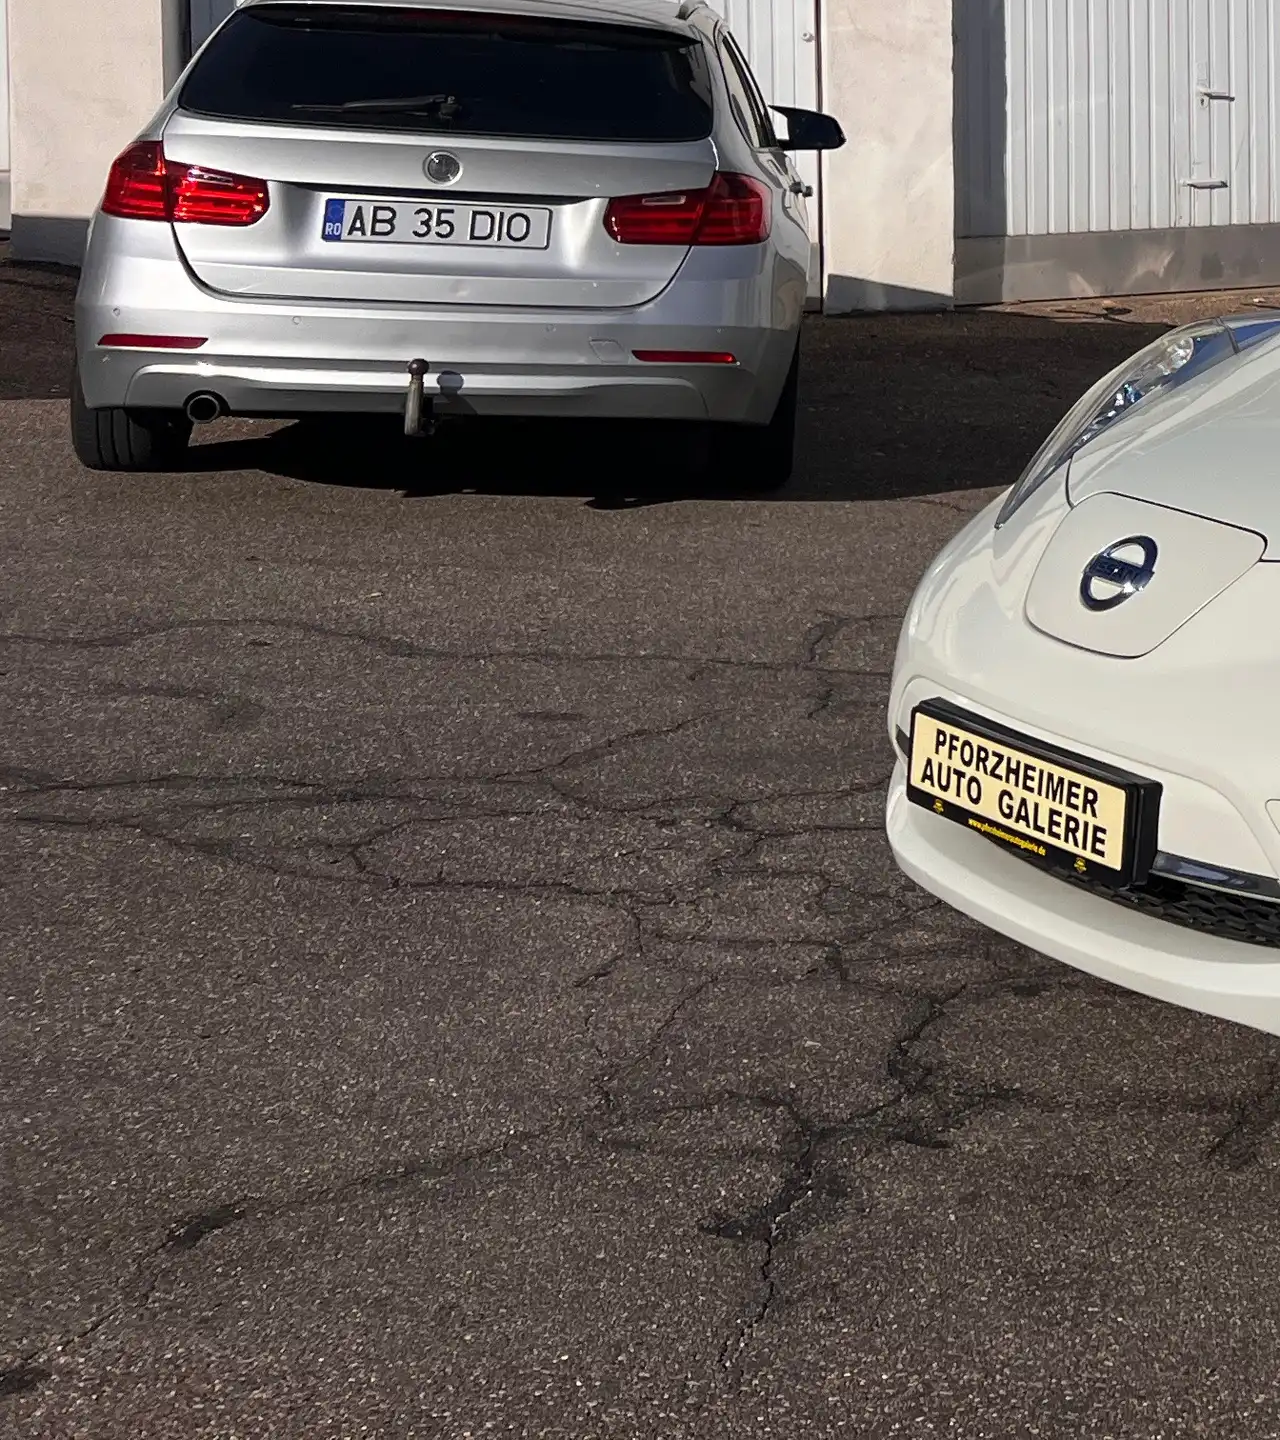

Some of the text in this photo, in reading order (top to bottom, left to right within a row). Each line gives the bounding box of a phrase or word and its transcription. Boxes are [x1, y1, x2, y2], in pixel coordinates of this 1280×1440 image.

[325, 222, 341, 235] RO
[347, 205, 531, 242] AB 35 DIO
[935, 728, 1099, 818] PFORZHEIMER
[921, 757, 982, 805] AUTO
[998, 790, 1108, 858] GALERIE
